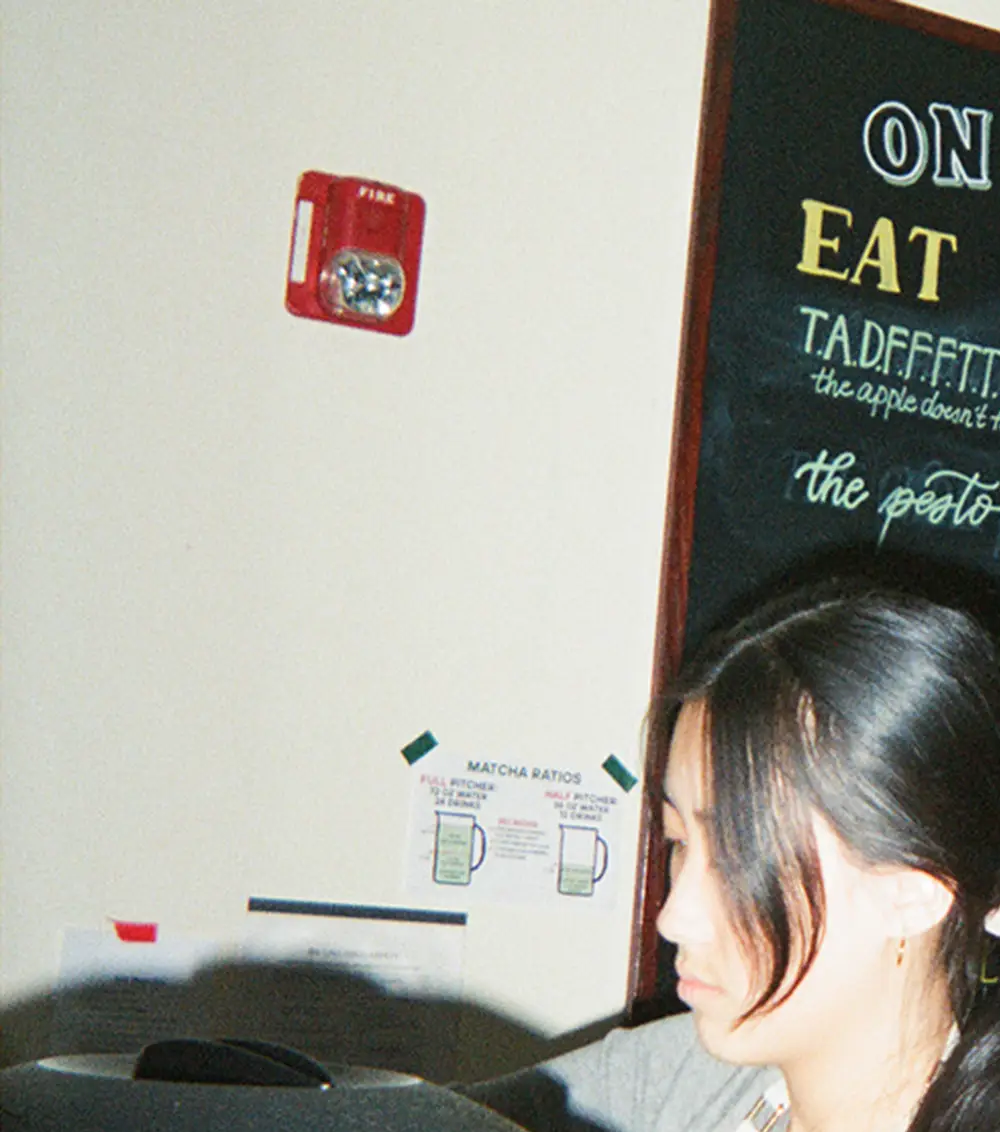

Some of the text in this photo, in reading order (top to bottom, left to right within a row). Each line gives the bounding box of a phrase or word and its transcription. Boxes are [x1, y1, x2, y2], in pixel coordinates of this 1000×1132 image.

[864, 101, 992, 190] ON
[359, 186, 396, 204] FIRE
[796, 198, 958, 301] EAT
[810, 366, 854, 398] the
[856, 381, 918, 421] apple
[920, 389, 988, 429] doesn't
[795, 449, 871, 511] the
[420, 774, 496, 793] FULL PITCHER
[467, 760, 582, 786] MATCHA RATIOS
[449, 798, 482, 811] DRINKS
[457, 790, 487, 801] WATER
[544, 790, 572, 802] HALF
